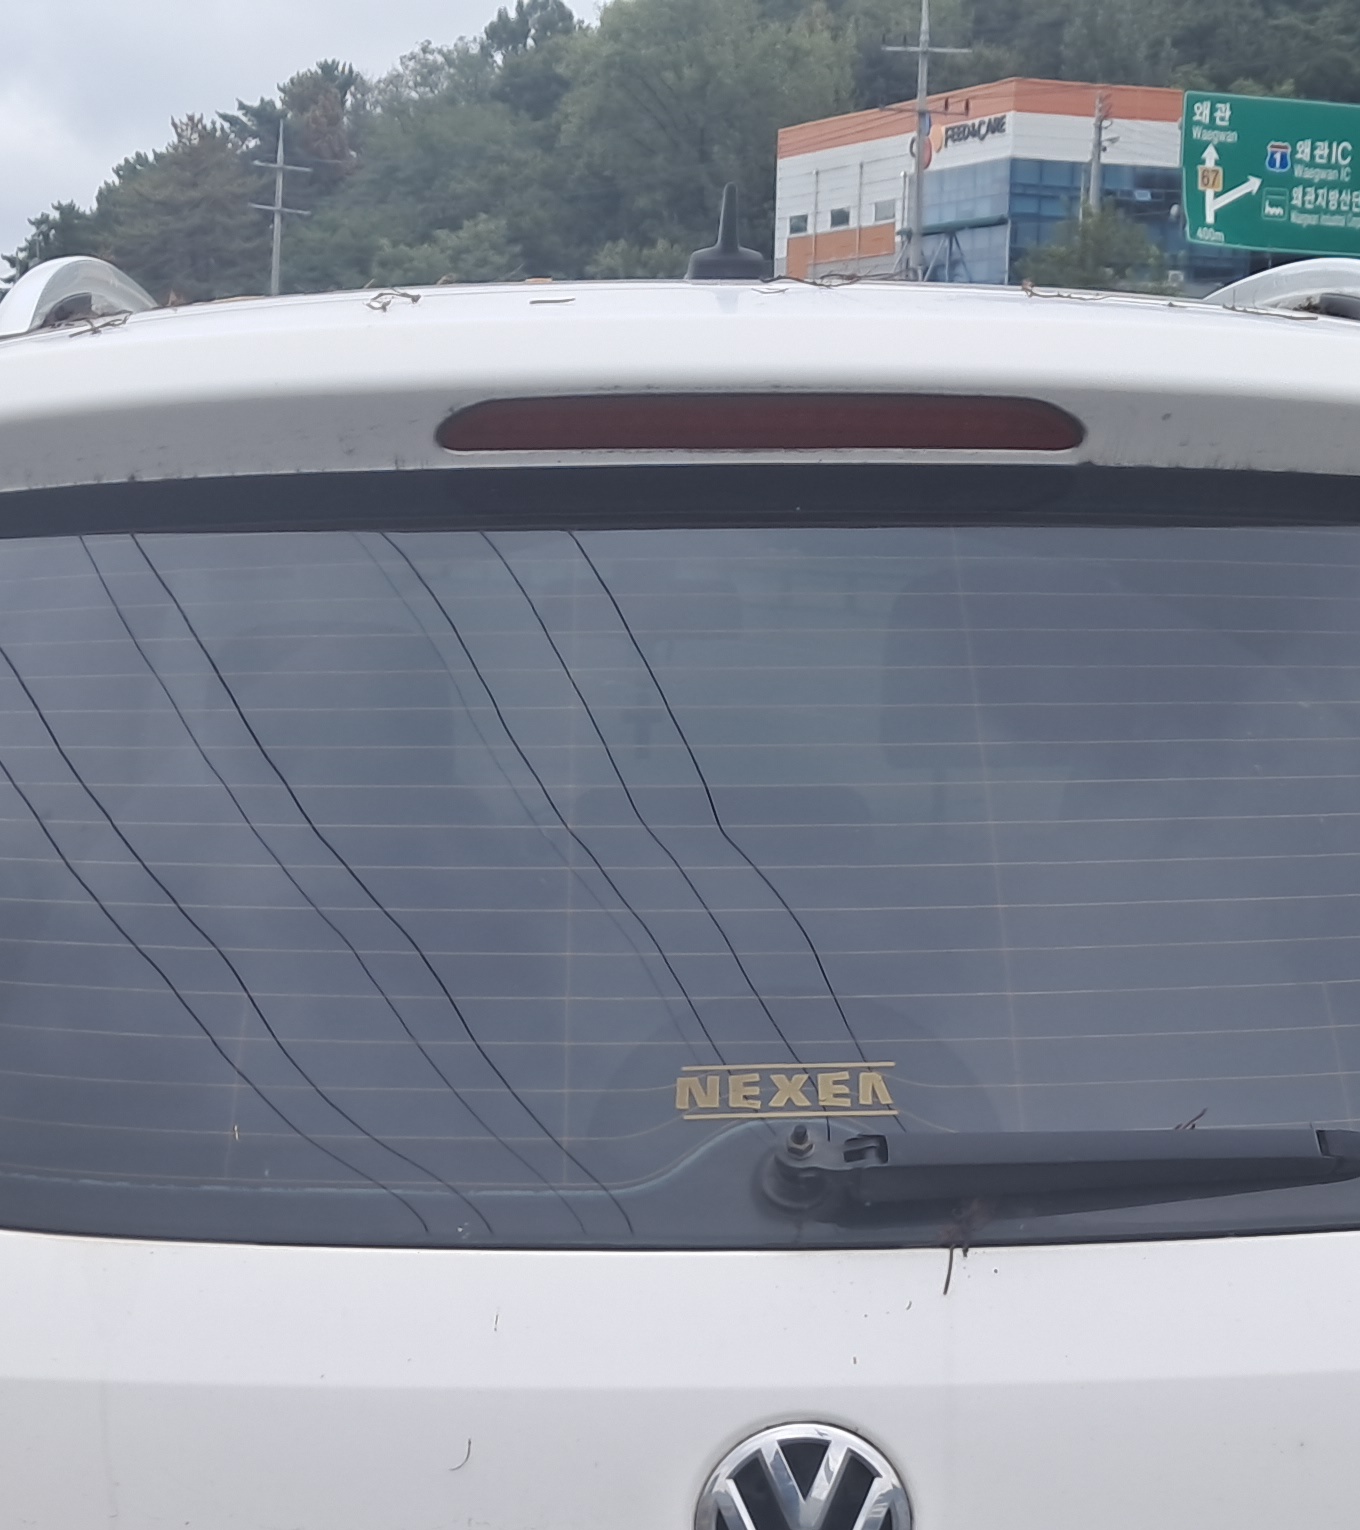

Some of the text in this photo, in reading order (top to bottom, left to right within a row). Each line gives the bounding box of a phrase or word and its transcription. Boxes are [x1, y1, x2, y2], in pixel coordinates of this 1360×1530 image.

[1192, 101, 1232, 126] 왜관
[1192, 125, 1238, 144] Waegwan
[1295, 139, 1353, 165] 왜관IC
[1201, 169, 1220, 187] 67
[1340, 166, 1352, 182] IC
[1196, 226, 1225, 243] 400m
